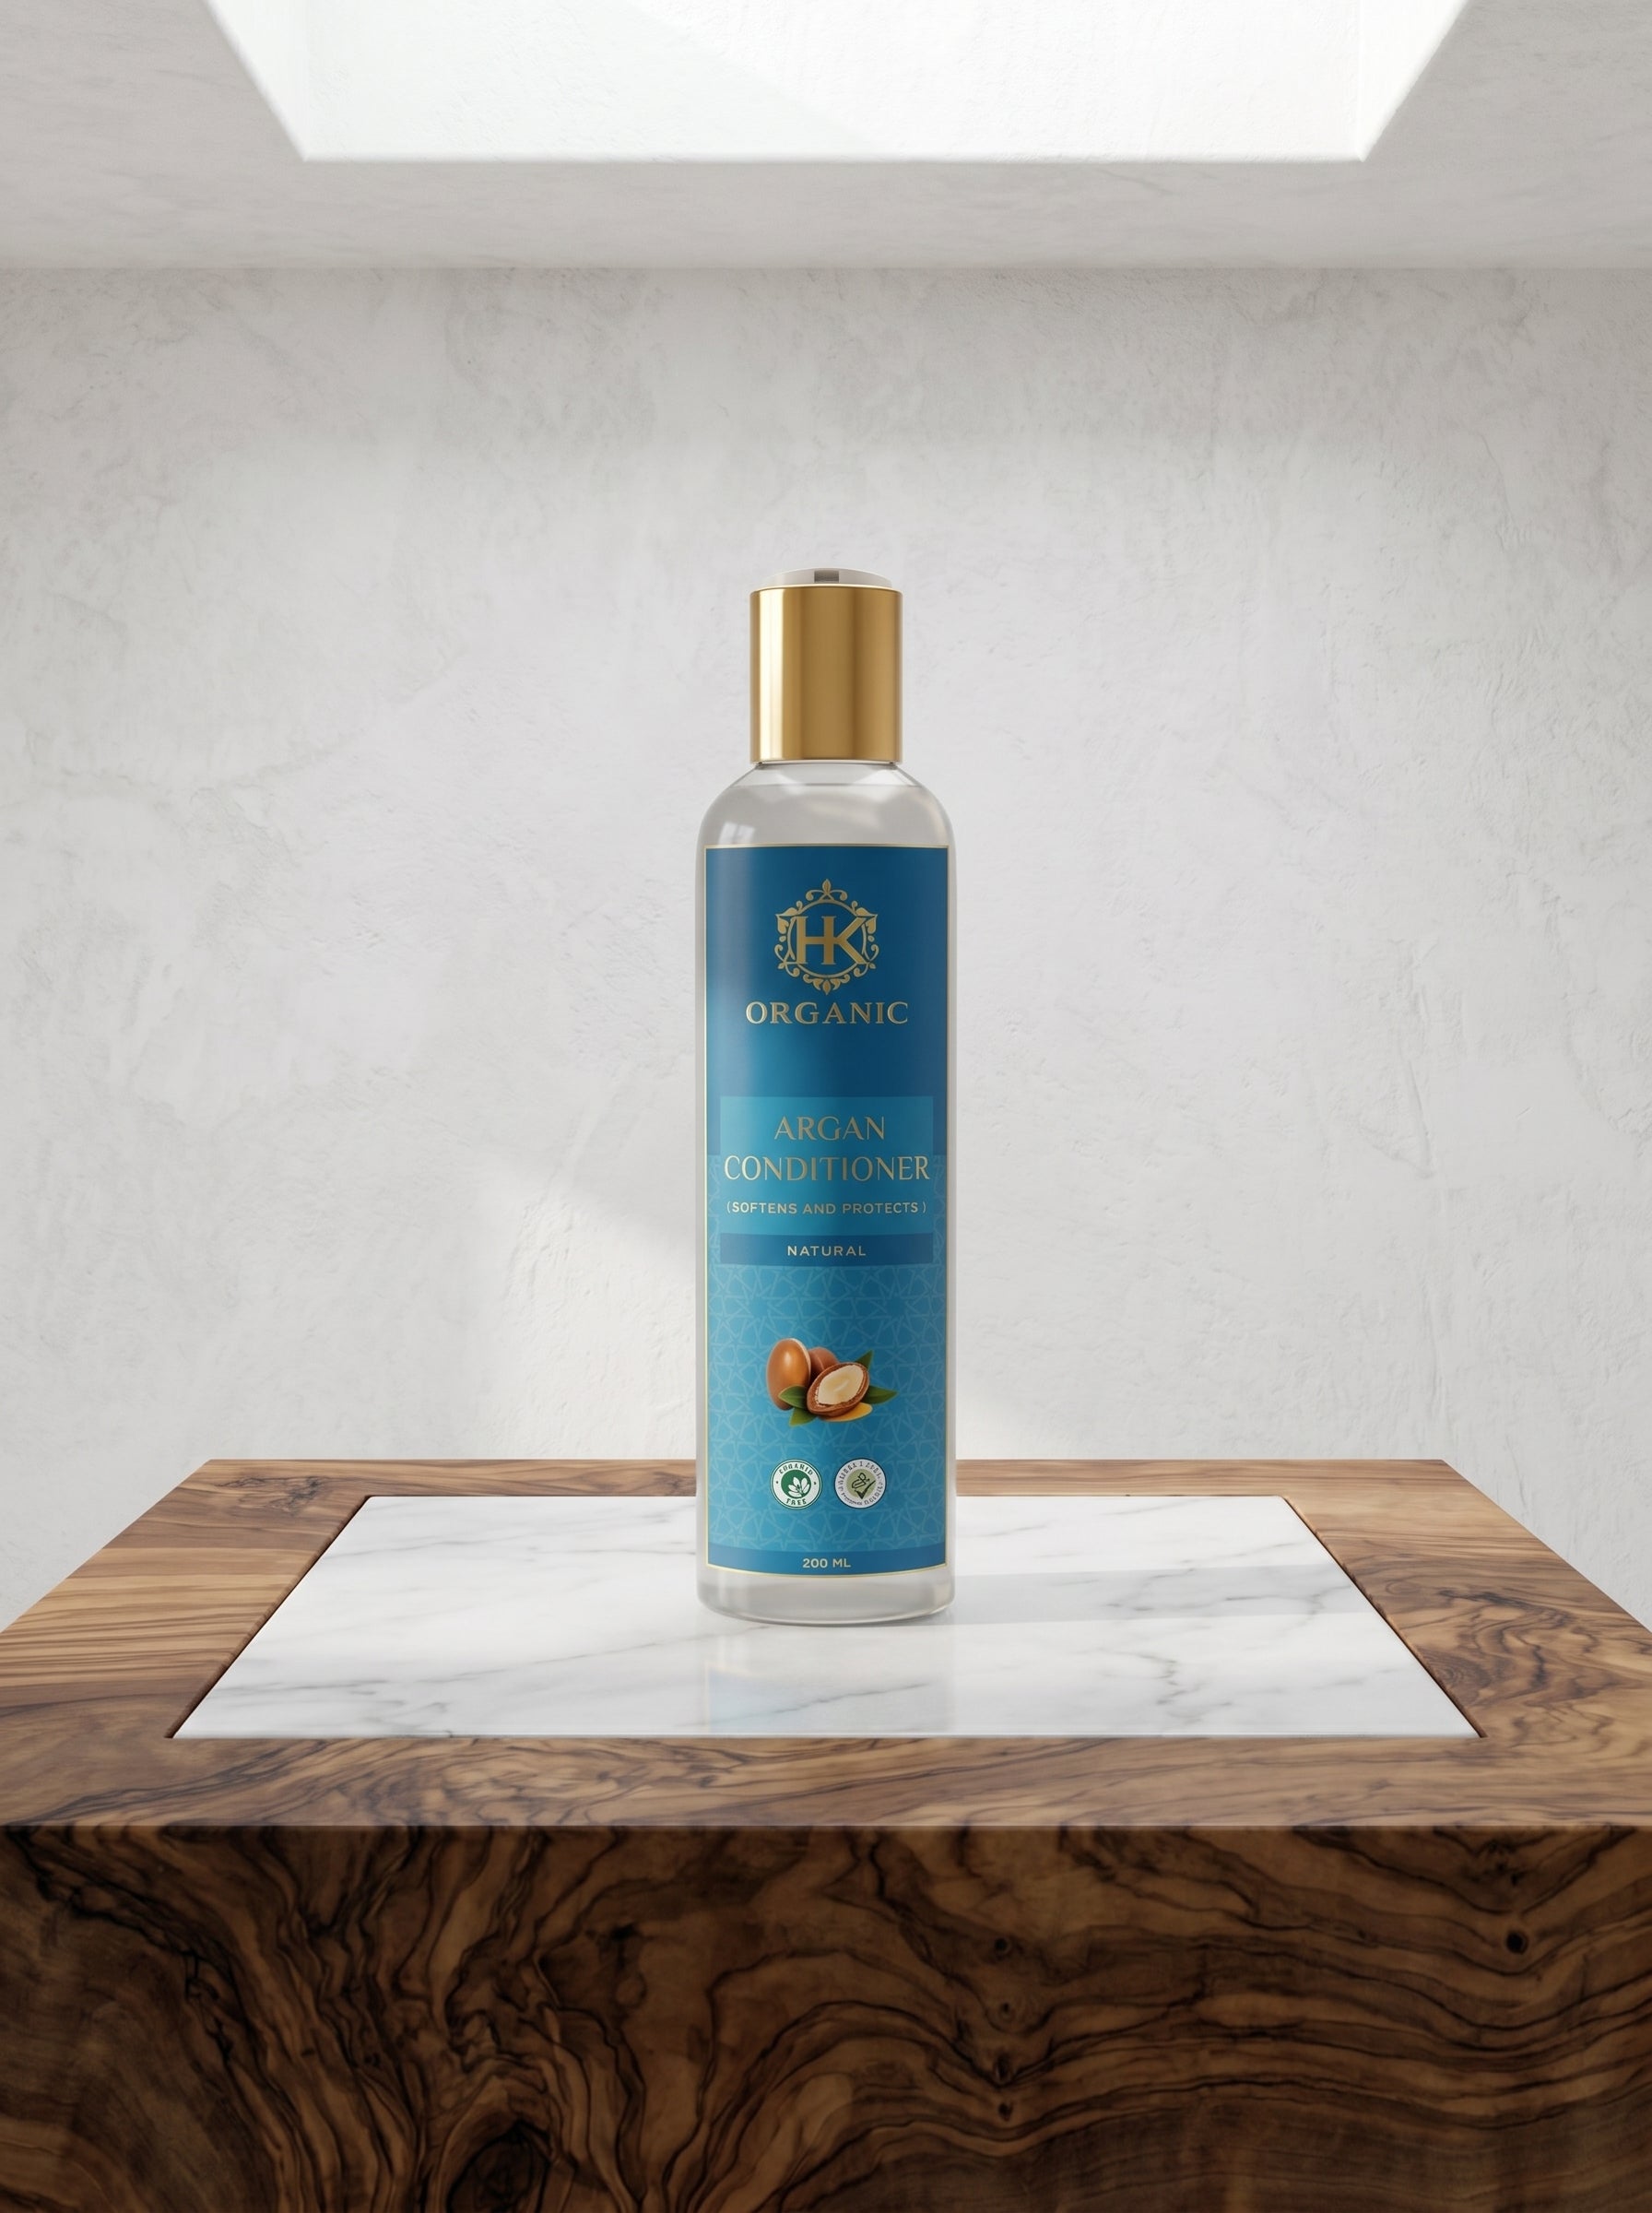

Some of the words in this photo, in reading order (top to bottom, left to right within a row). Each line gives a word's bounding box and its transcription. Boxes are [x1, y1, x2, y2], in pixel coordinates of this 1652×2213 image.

[785, 916, 868, 965] HK
[745, 1000, 908, 1024] ORGANIC
[773, 1116, 885, 1141] ARGAN
[724, 1154, 930, 1182] CONDITIONER
[726, 1201, 797, 1214] (SOFTENS
[802, 1201, 836, 1214] AND
[787, 1246, 867, 1257] NATURAL
[802, 1557, 828, 1568] 200
[832, 1557, 852, 1568] ML
